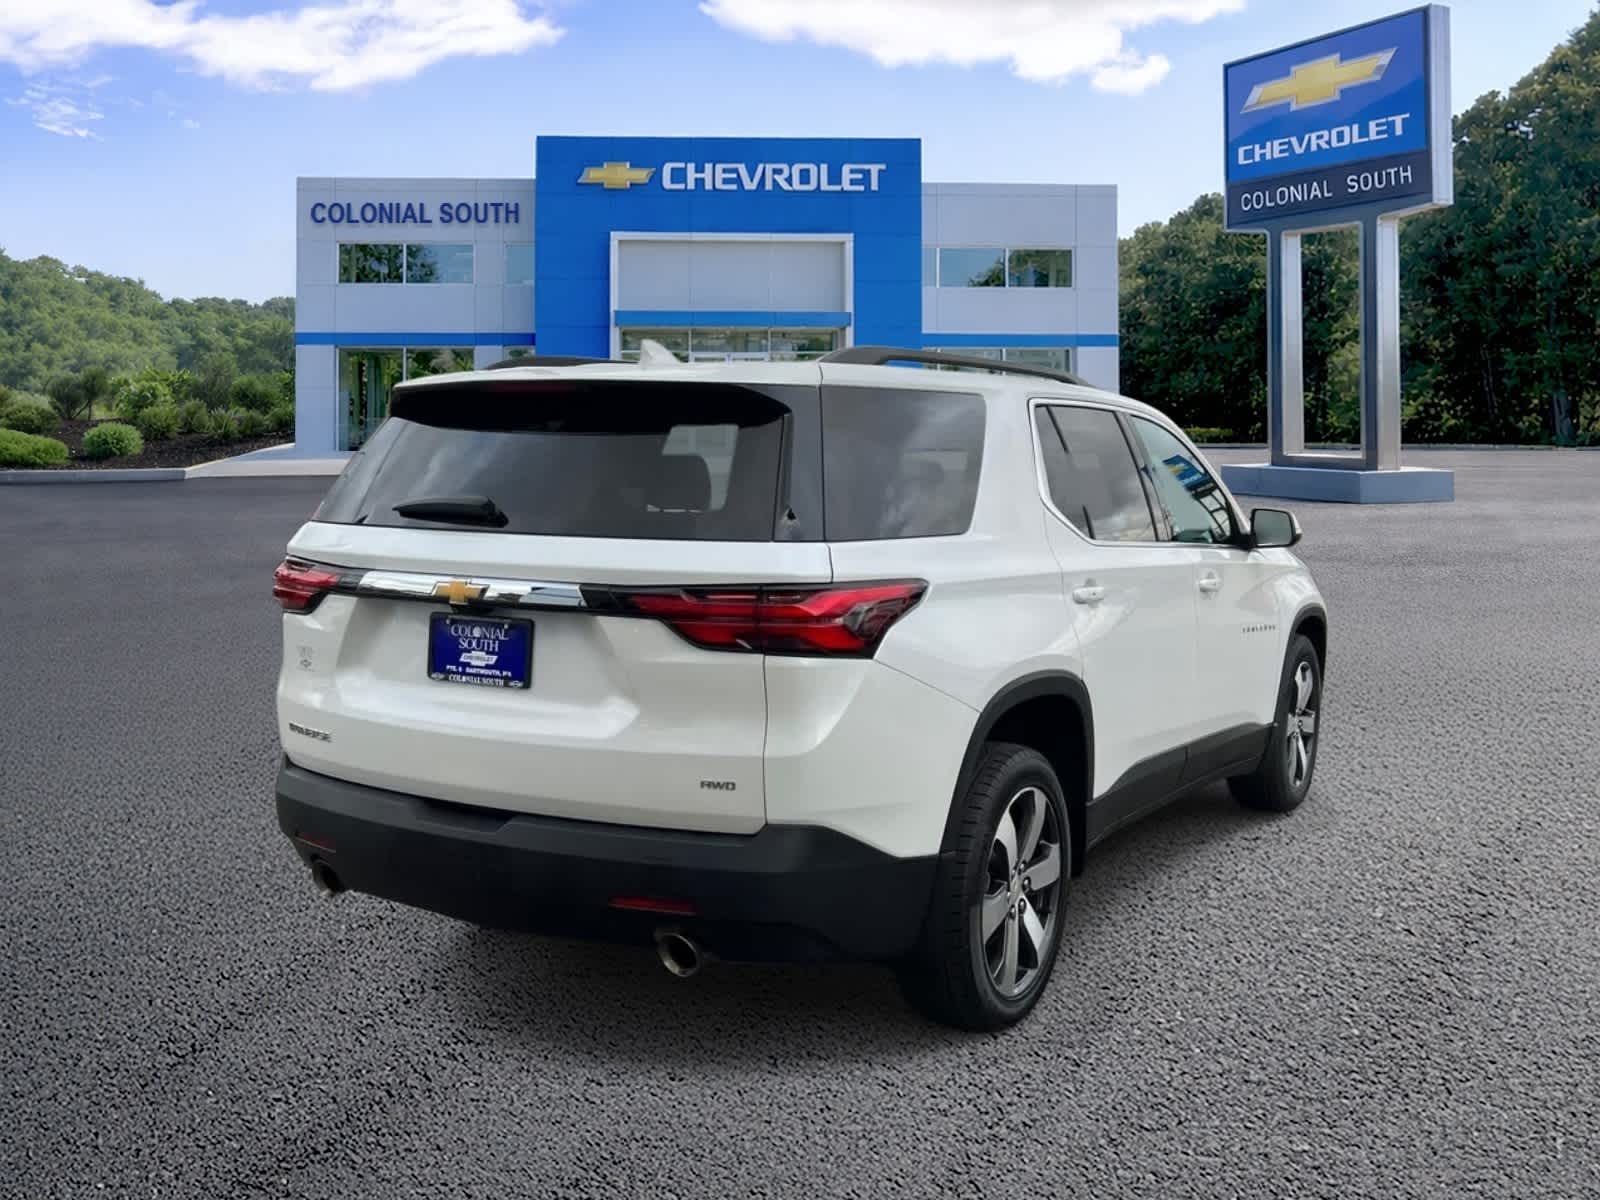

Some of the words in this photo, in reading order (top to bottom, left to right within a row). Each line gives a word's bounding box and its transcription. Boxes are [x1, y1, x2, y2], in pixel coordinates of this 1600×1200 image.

[1237, 112, 1411, 165] CHEVROLET
[661, 161, 888, 192] CHEVROLET
[1240, 179, 1333, 211] COLONIAL
[1346, 164, 1413, 193] SOUTH
[310, 202, 433, 224] COLONIAL
[439, 202, 520, 224] SOUTH
[450, 623, 509, 640] COLONIAL
[458, 637, 499, 652] SOUTH
